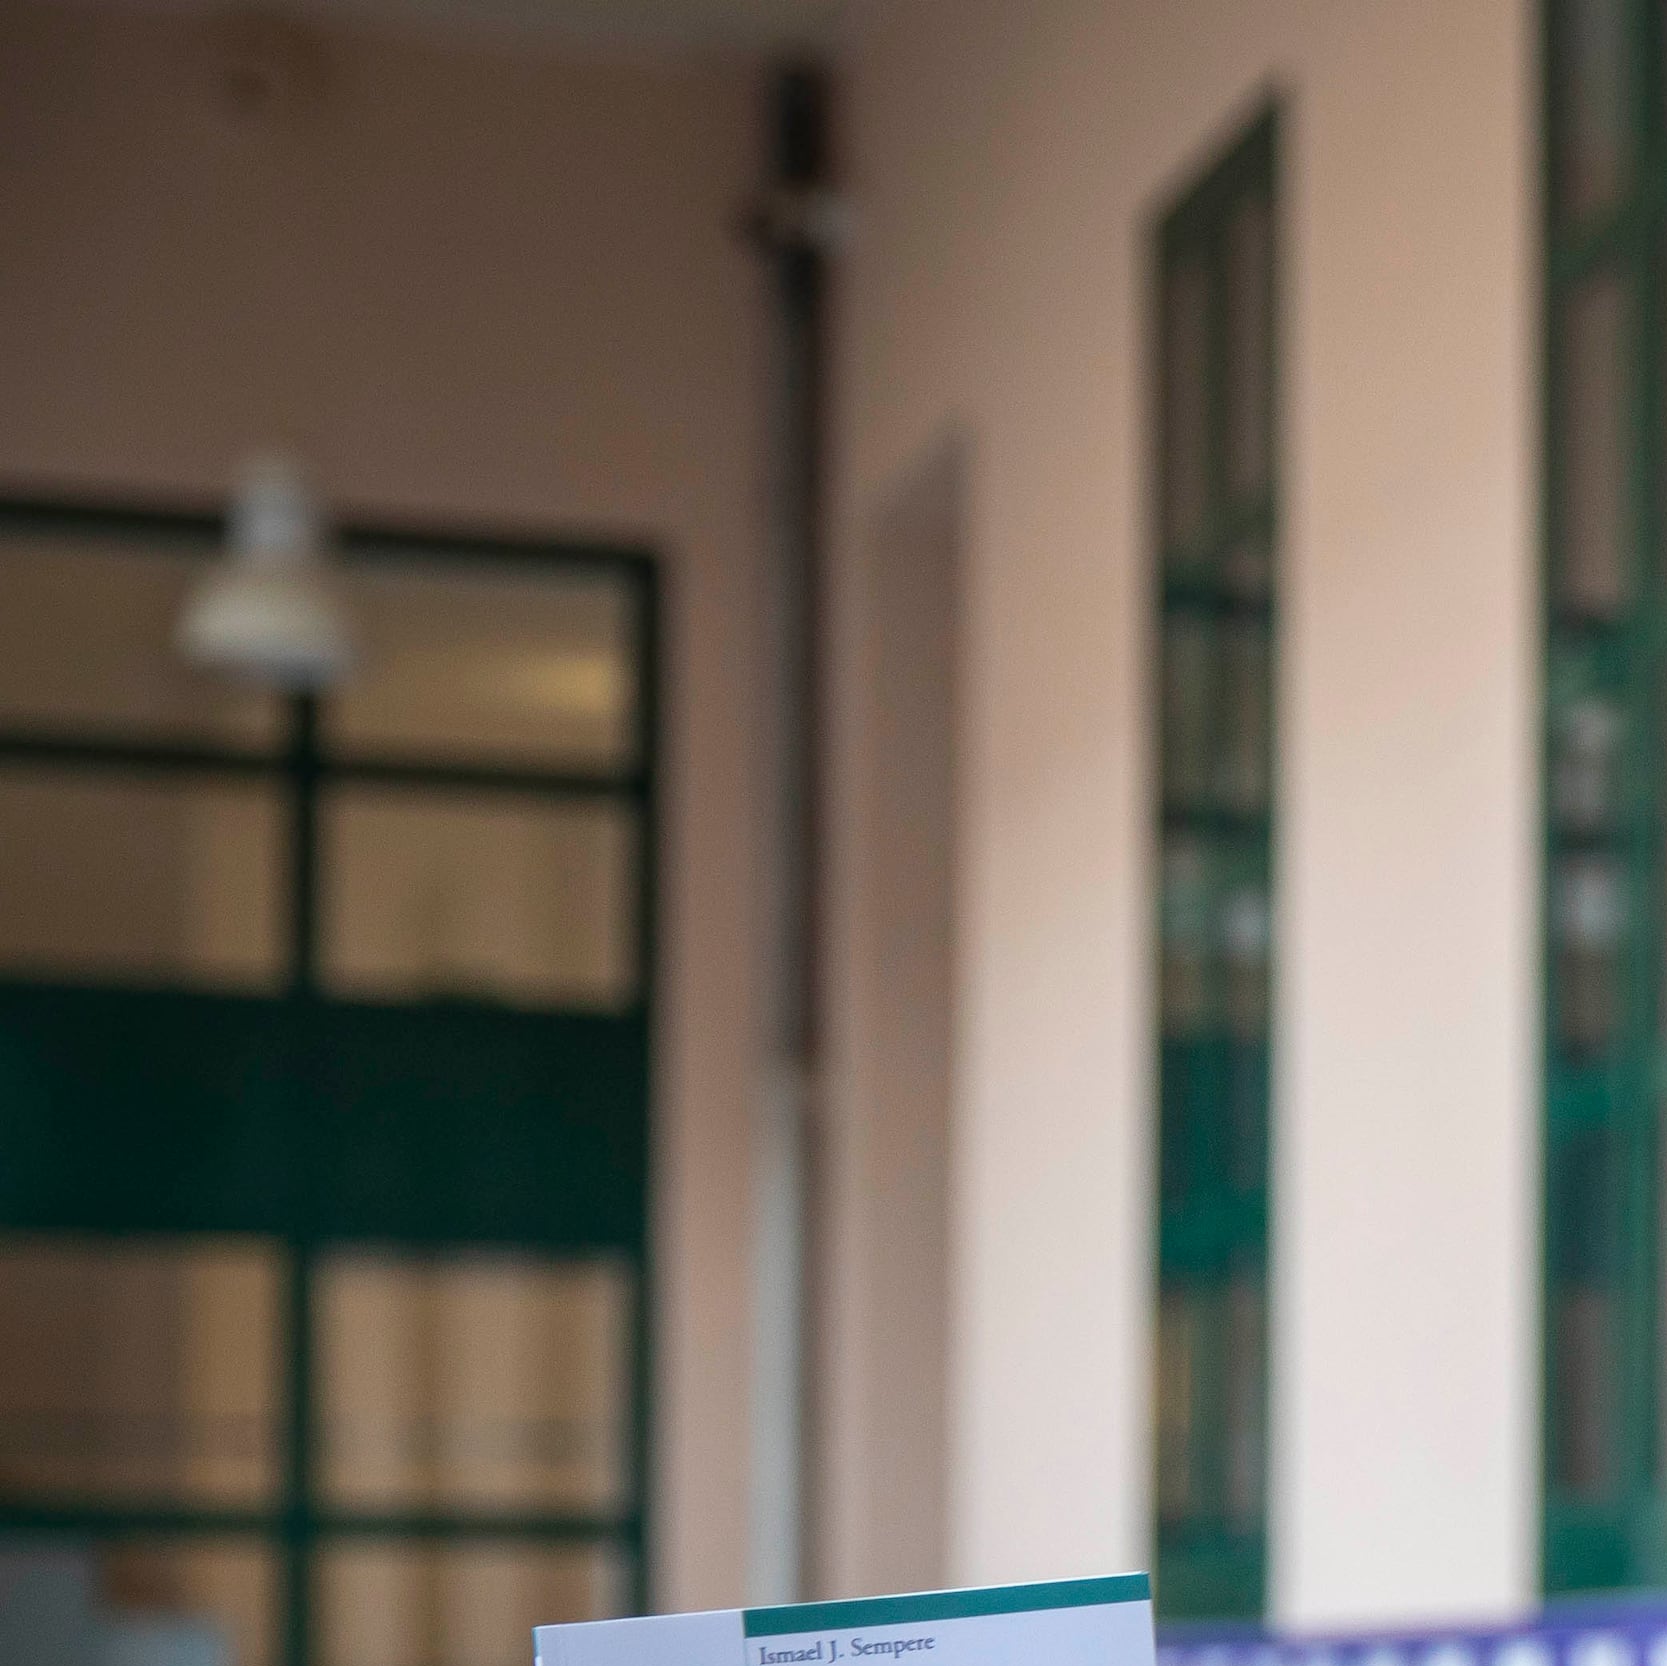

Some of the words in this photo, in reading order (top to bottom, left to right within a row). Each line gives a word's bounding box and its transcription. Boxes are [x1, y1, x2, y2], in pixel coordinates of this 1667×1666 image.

[759, 1641, 822, 1666] Ismael
[828, 1640, 844, 1664] J.
[851, 1636, 936, 1659] Sempere
